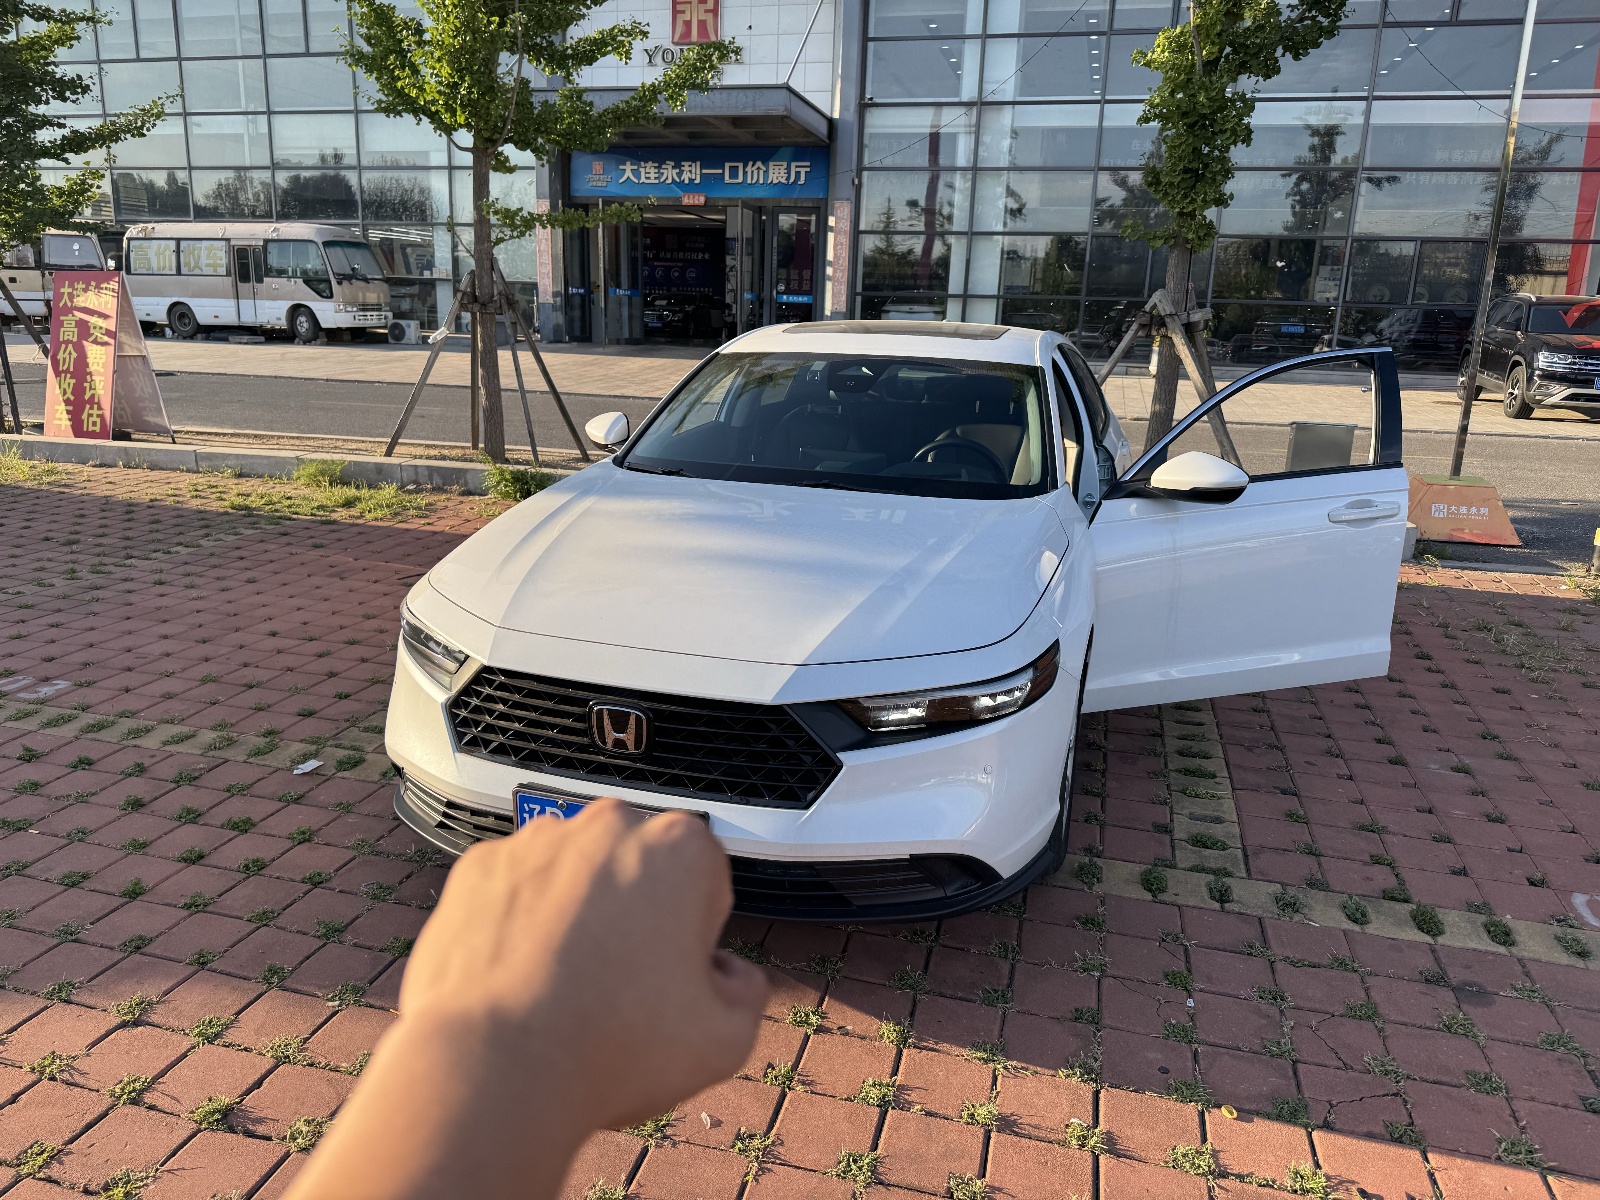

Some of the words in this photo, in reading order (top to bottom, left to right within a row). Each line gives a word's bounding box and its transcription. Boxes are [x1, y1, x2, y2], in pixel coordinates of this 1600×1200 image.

[619, 160, 811, 185] 大连永利一口价展厅
[131, 243, 225, 273] 高价收车
[59, 280, 113, 309] 大连永利
[53, 313, 80, 431] 高价收车
[82, 314, 107, 433] 免费评估
[1448, 505, 1489, 515] 大连永利
